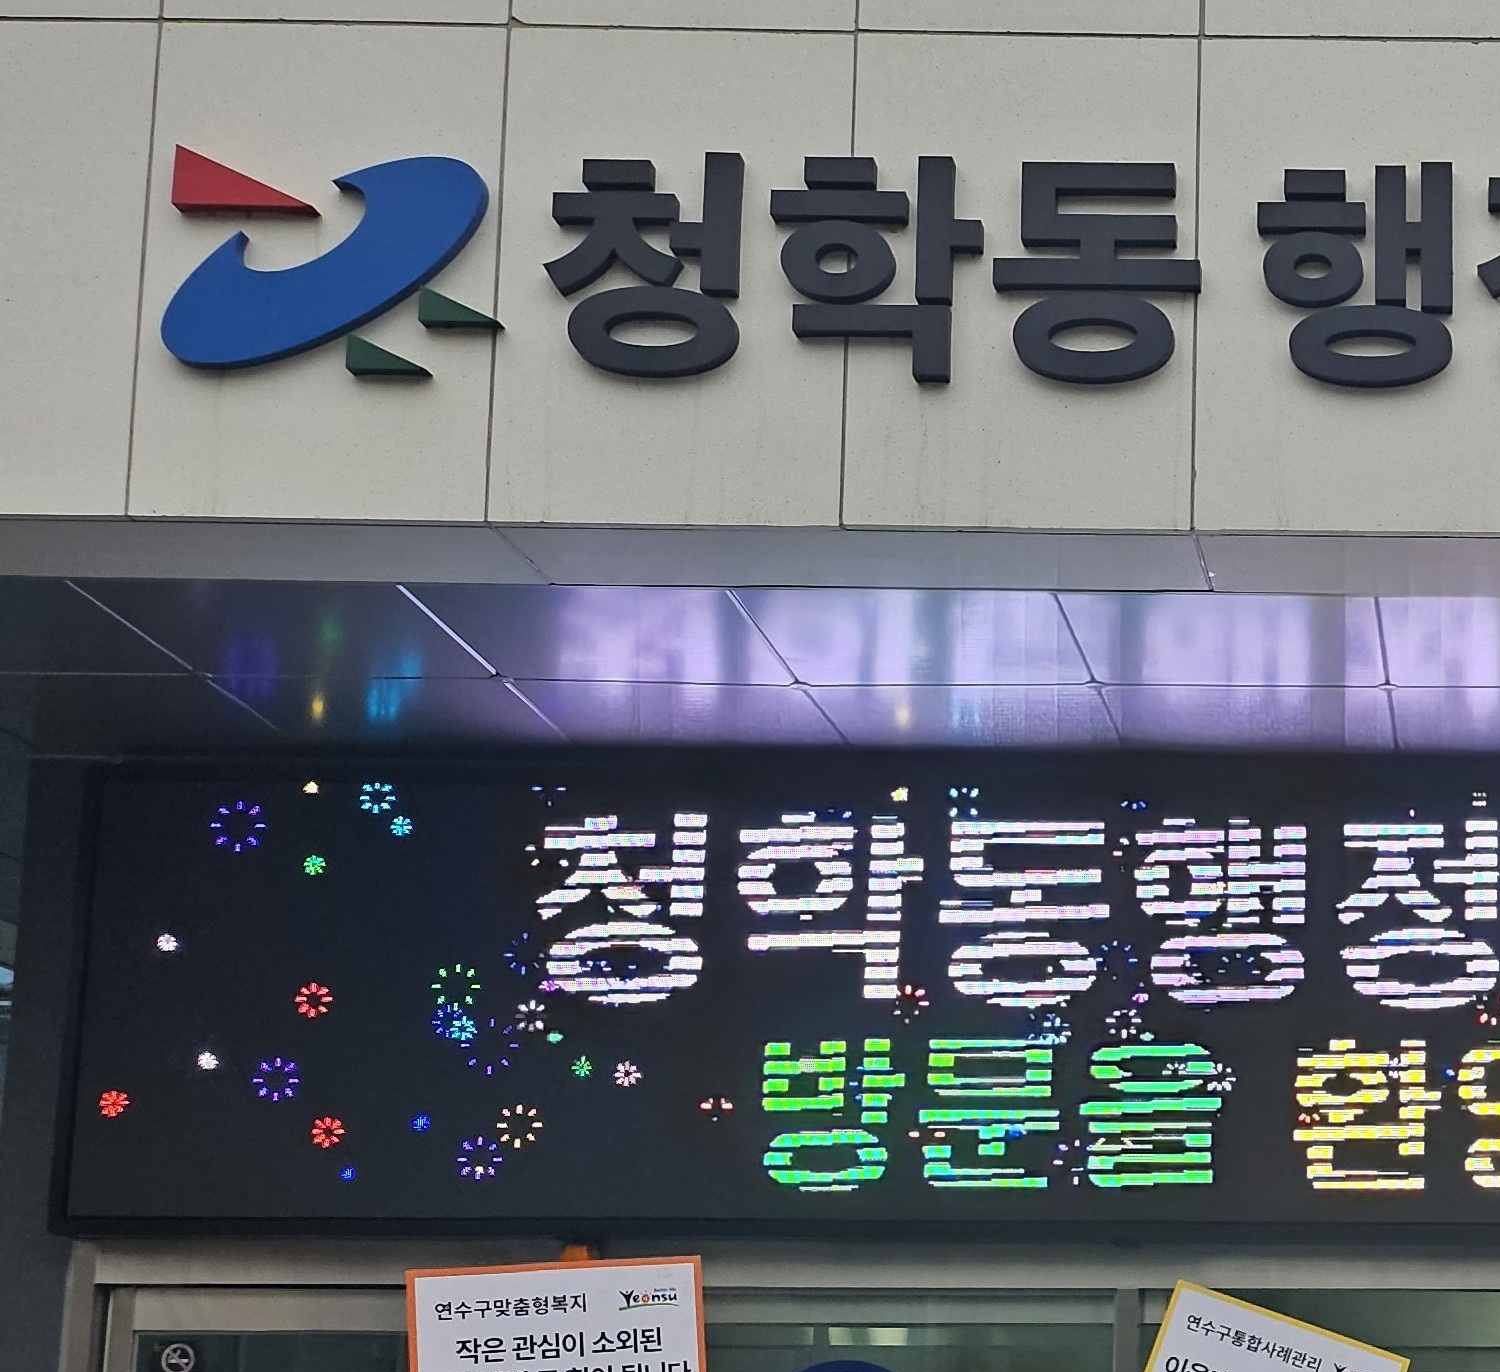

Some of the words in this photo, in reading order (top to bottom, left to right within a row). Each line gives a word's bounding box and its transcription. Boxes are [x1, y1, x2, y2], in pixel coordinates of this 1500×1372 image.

[544, 151, 1203, 386] 청학동
[762, 1038, 1222, 1192] 방문을
[434, 1292, 587, 1321] 연수구맞춤형복지
[619, 1289, 678, 1309] Yeonsu
[455, 1338, 507, 1365] 작은
[512, 1330, 585, 1360] 관심이
[591, 1326, 663, 1354] 소외된
